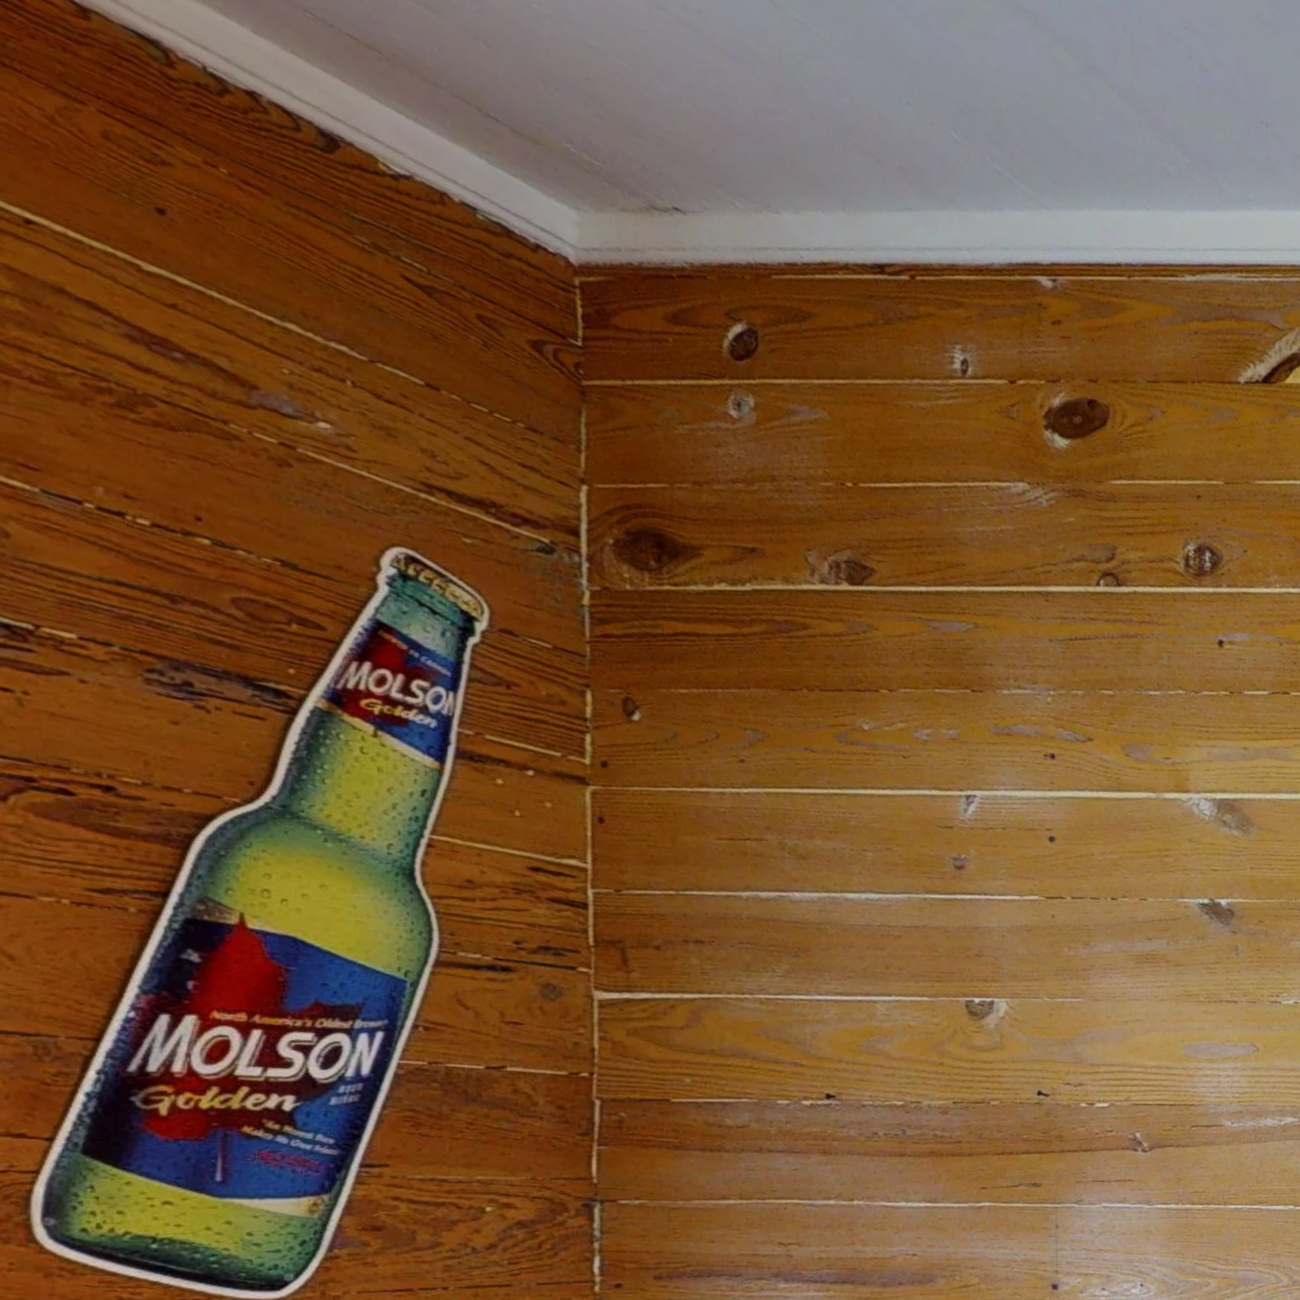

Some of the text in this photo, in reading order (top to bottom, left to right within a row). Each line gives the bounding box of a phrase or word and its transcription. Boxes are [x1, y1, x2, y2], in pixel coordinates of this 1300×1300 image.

[336, 660, 456, 717] MOLSON
[360, 698, 438, 729] Golden
[126, 1013, 385, 1083] MOLSON
[129, 1084, 303, 1116] Golden
